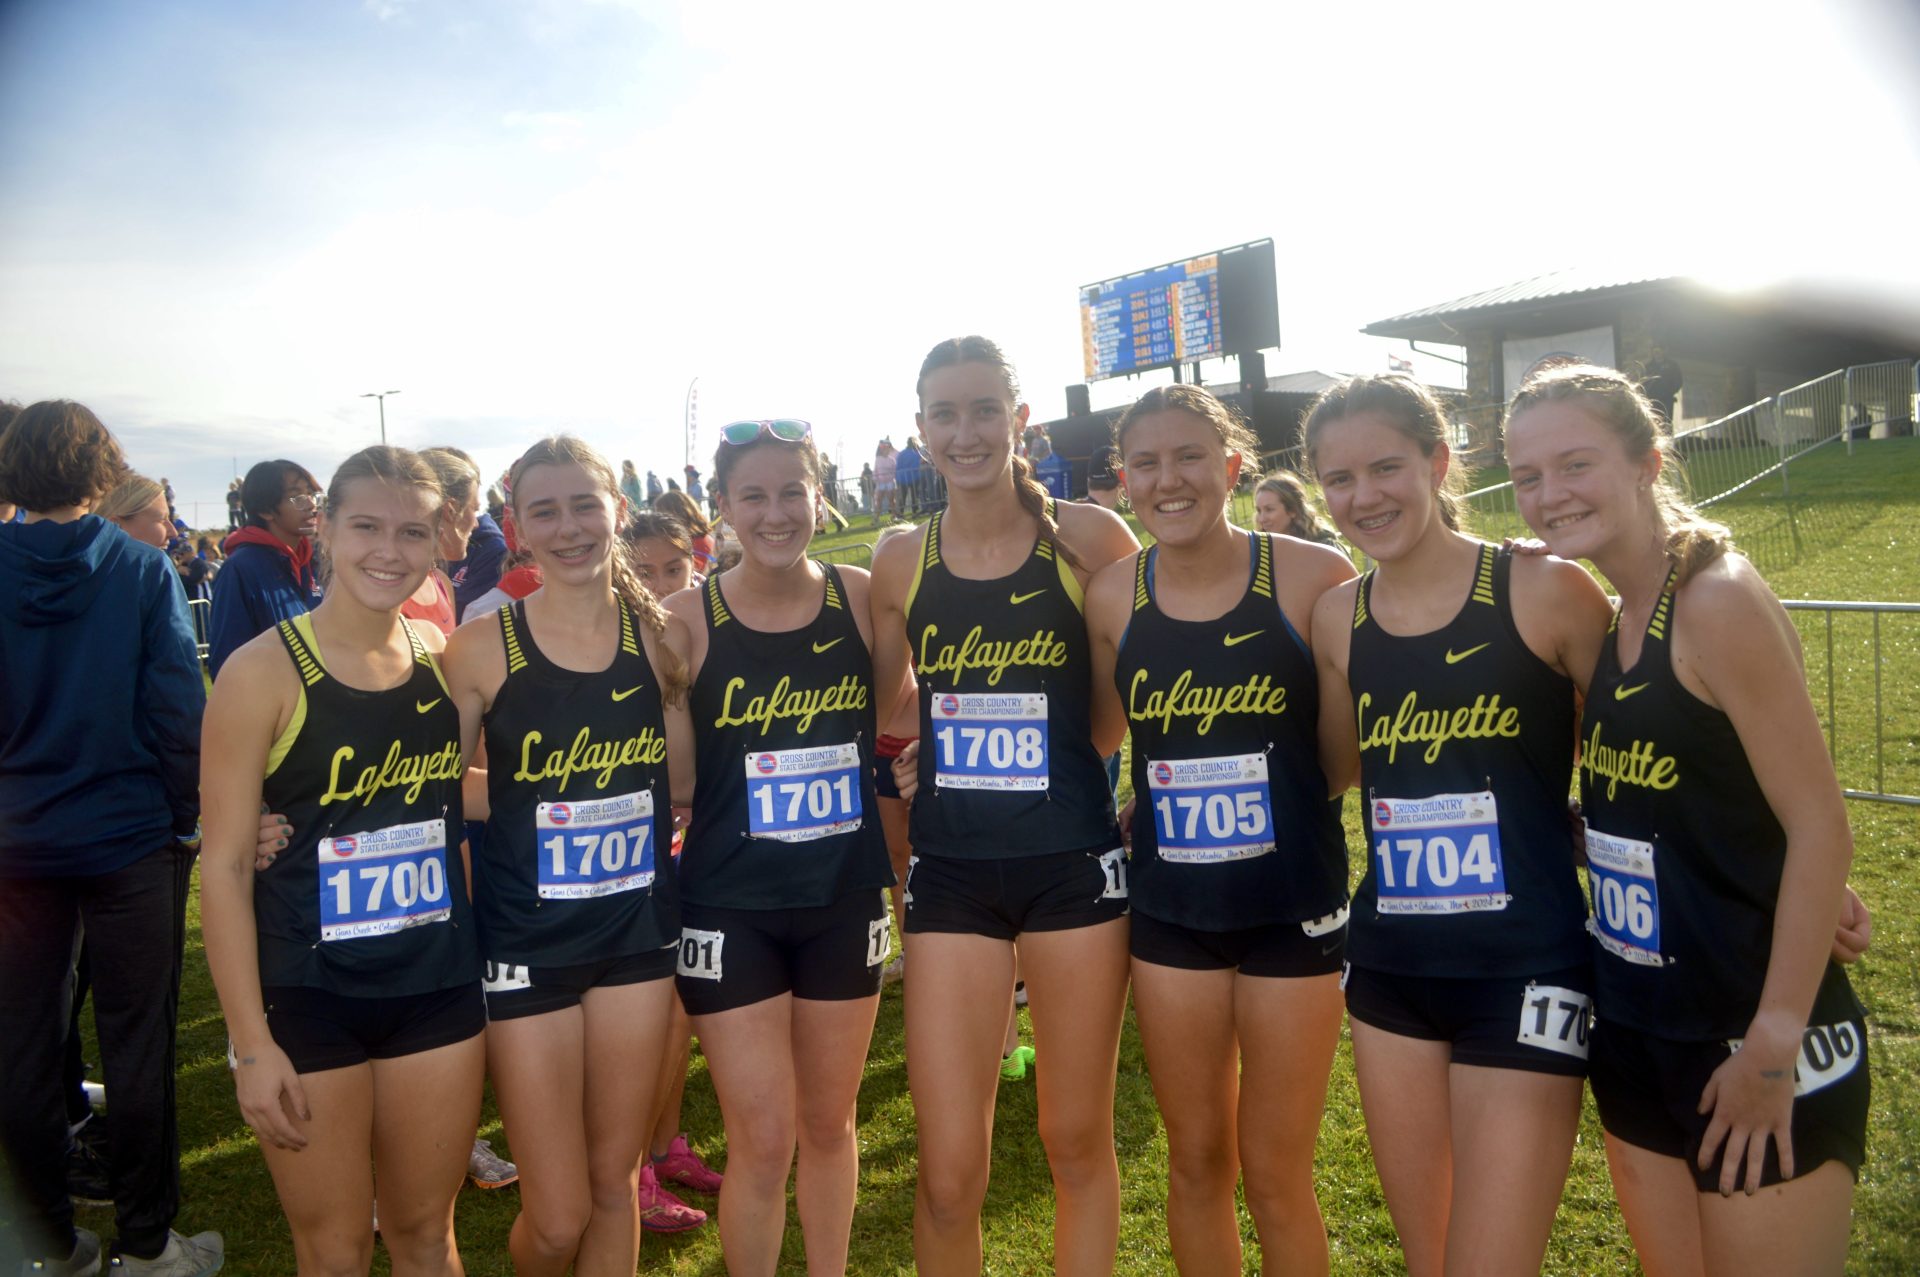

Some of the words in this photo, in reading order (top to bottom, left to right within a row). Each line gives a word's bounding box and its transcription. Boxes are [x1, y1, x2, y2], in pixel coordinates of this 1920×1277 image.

[917, 623, 1067, 687] Lafayette
[714, 675, 867, 736] Lafayette
[961, 698, 985, 707] CROSS
[986, 698, 1022, 707] COUNTRY
[961, 707, 978, 715] STATE
[979, 707, 1024, 715] CHAMPIONSHIP
[1130, 668, 1287, 736] Lafayette
[937, 726, 1043, 769] 1708
[1358, 690, 1520, 765] Lafayette
[319, 739, 462, 806] Lafayette
[513, 726, 666, 793] Lafayette
[780, 753, 803, 764] CROSS
[805, 749, 838, 761] COUNTRY
[780, 762, 797, 771] STATE
[798, 758, 839, 770] CHAMPIONSHIP
[1174, 775, 1192, 783] STATE
[1193, 772, 1241, 783] CHAMPIONSHIP
[1175, 764, 1198, 774] CROSS
[1200, 761, 1239, 773] COUNTRY
[1580, 721, 1679, 802] fayette
[574, 814, 592, 823] STATE
[593, 807, 635, 821] CHAMPIONSHIP
[575, 804, 600, 815] CROSS
[602, 798, 633, 812] COUNTRY
[753, 775, 852, 824] 1701
[1156, 791, 1266, 839] 1705
[1393, 803, 1419, 814] CROSS
[1421, 798, 1463, 813] COUNTRY
[1393, 815, 1411, 824] STATE
[1412, 811, 1466, 823] CHAMPIONSHIP
[360, 832, 387, 844] CROSS
[390, 826, 424, 841] COUNTRY
[360, 843, 380, 854] STATE
[381, 837, 427, 851] CHAMPIONSHIP
[544, 824, 650, 876] 1707
[1376, 834, 1497, 887] 1704
[327, 857, 444, 915] 1700
